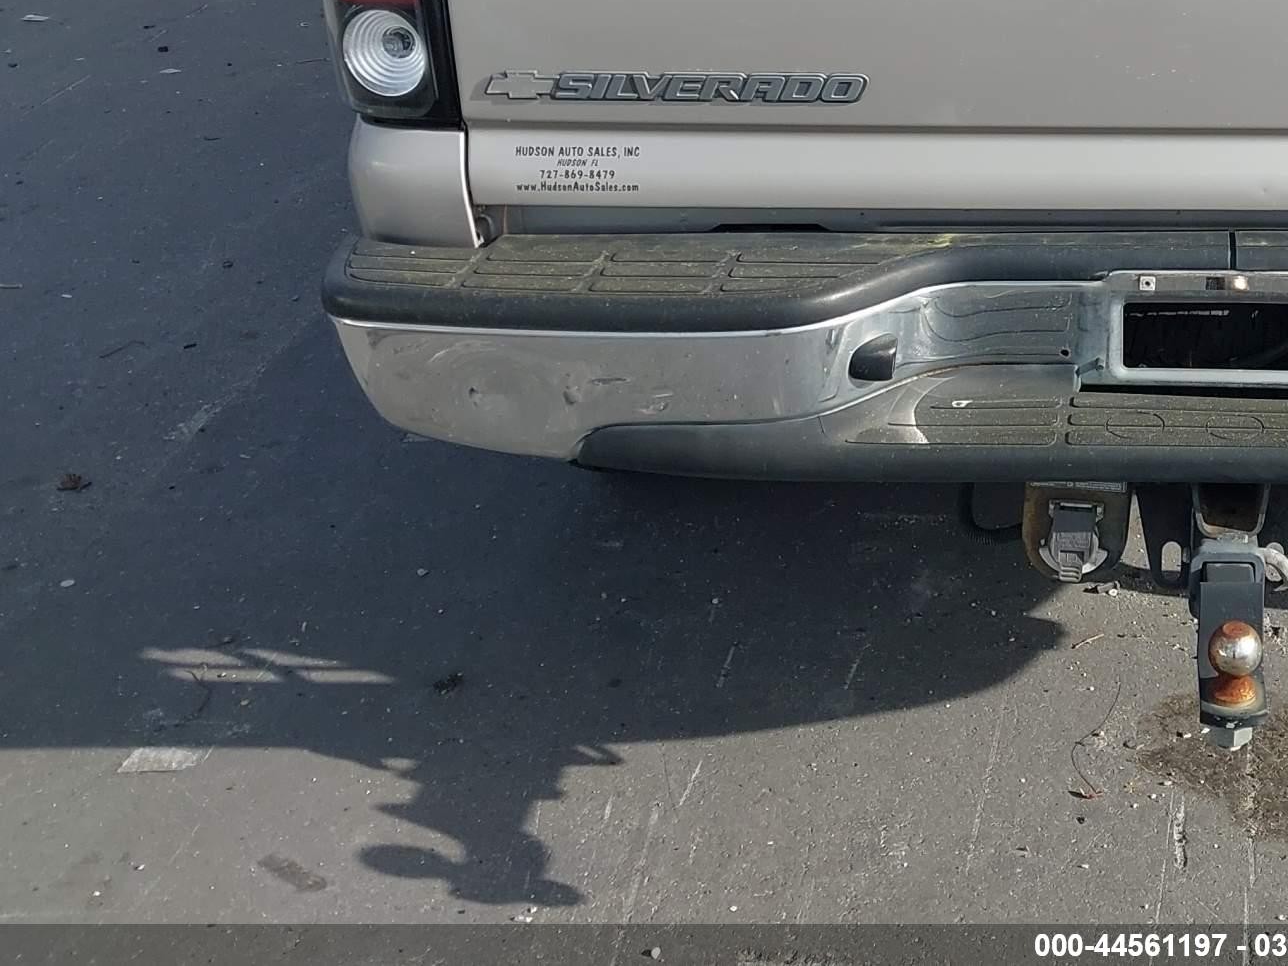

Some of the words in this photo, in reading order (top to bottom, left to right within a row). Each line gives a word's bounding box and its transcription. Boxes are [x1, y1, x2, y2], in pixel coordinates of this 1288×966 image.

[552, 71, 869, 103] SILVERADO
[515, 146, 555, 157] HUDSON
[559, 146, 584, 157] AUTO
[587, 146, 621, 159] SALES,
[623, 146, 640, 157] INC
[556, 158, 587, 167] HUDSON
[591, 159, 599, 167] FL
[539, 169, 616, 180] 727-869-8479
[516, 181, 640, 192] www.HudsonAutoSales.com
